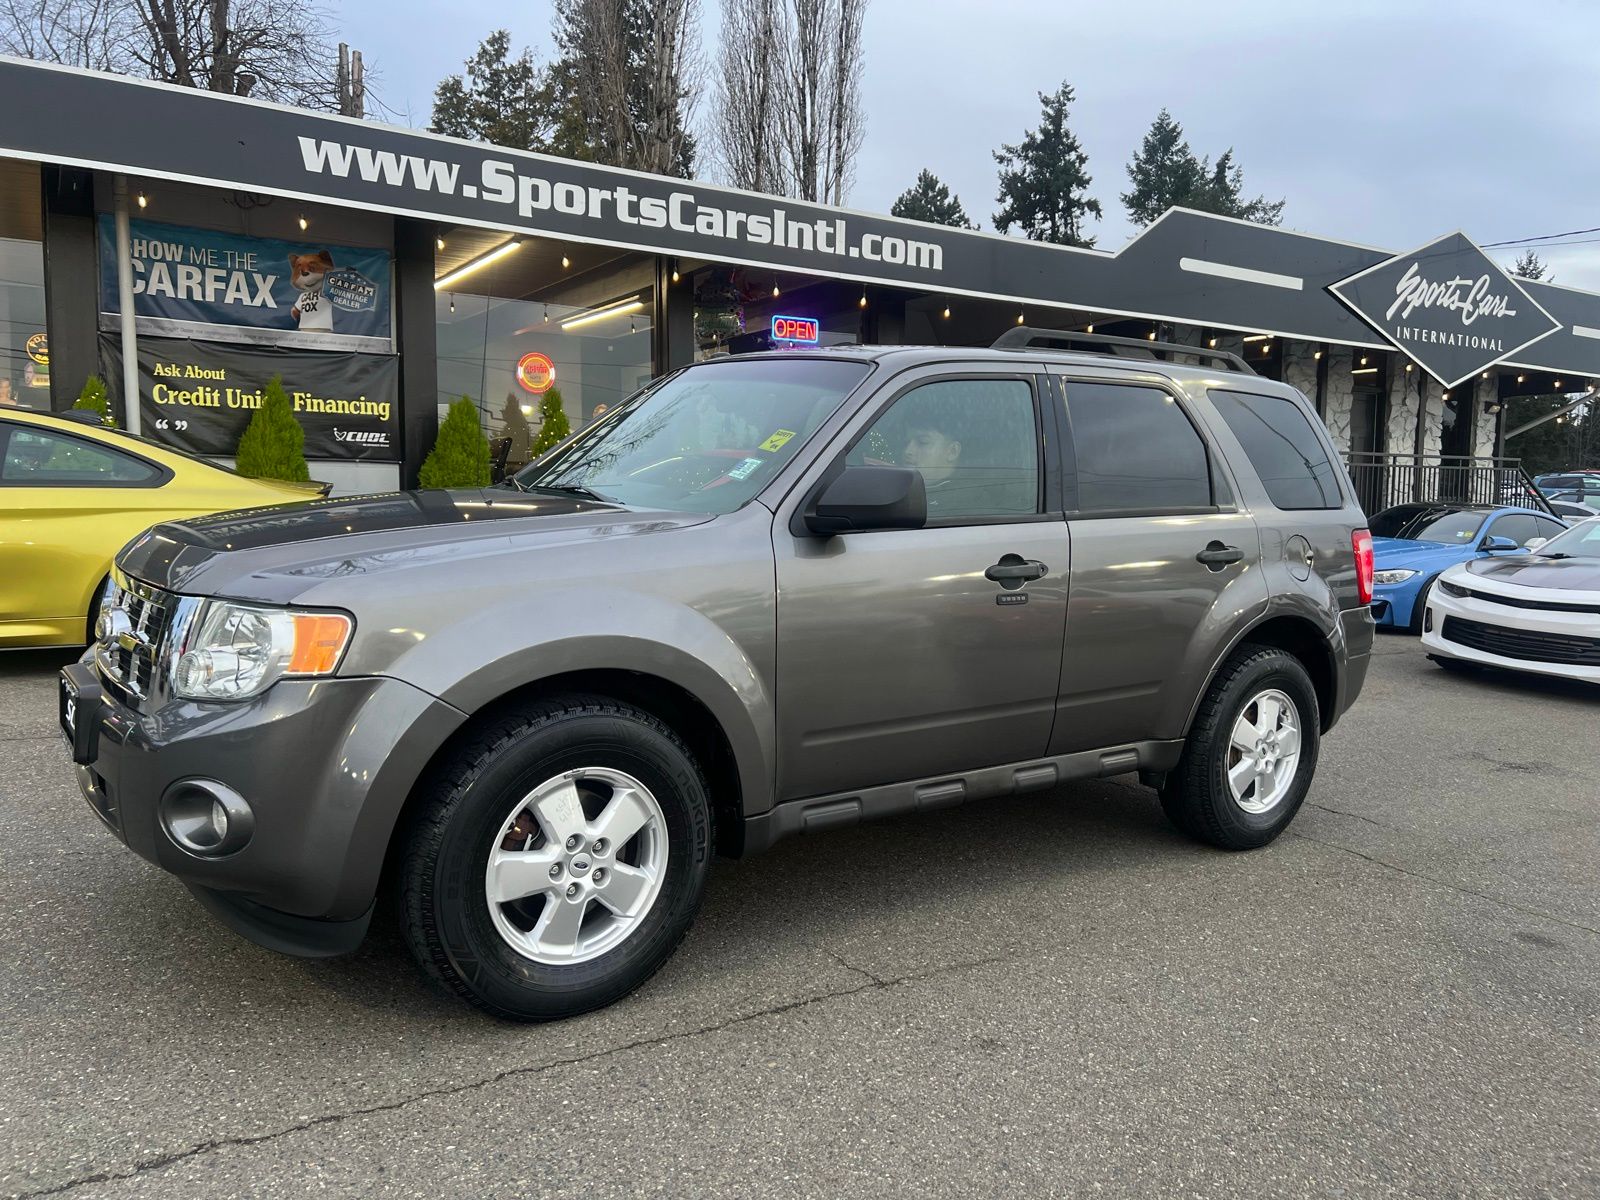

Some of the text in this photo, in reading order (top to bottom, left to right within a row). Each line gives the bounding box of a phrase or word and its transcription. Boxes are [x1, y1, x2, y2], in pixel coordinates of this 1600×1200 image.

[297, 136, 943, 270] www.SportsCarsIntl.com
[130, 239, 258, 272] HOW ME THE
[131, 258, 278, 309] CARFAX
[329, 277, 374, 296] CARFAX
[1386, 262, 1516, 325] Sports Cars
[301, 291, 319, 303] CAR
[330, 287, 368, 304] ADVANTAGE
[333, 297, 360, 309] DEALER
[301, 302, 318, 312] FOX
[774, 319, 817, 340] OPEN
[1396, 326, 1504, 352] INTERNATIONAL
[153, 363, 226, 380] Ask About
[152, 383, 391, 421] Credit Uni Financing
